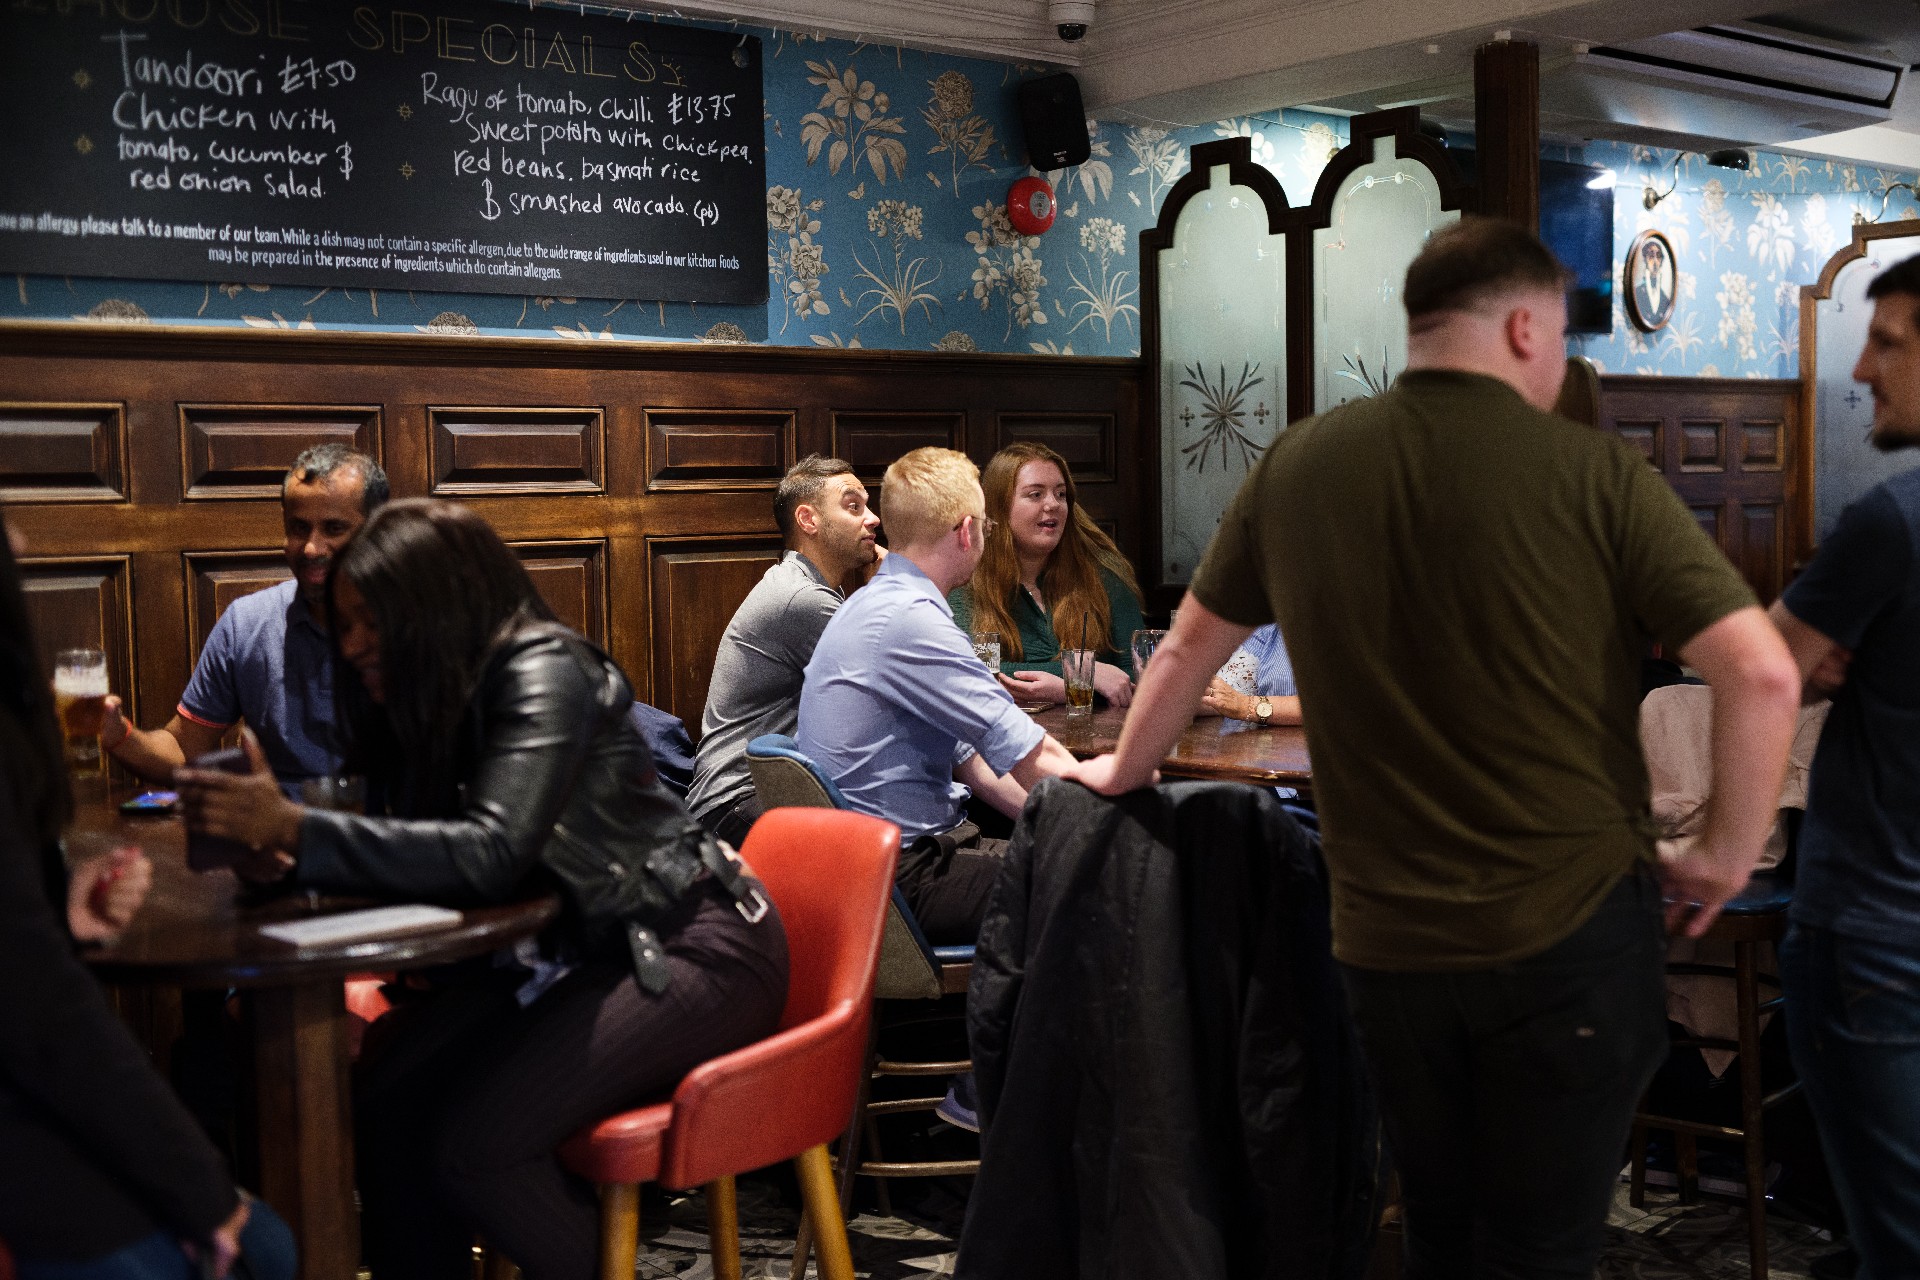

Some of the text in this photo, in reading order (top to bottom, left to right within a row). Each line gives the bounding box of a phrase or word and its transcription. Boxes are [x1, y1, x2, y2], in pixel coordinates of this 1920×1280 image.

[101, 28, 356, 96] Tandoori £7.50
[347, 7, 657, 82] SPECIALS
[113, 91, 335, 133] Chicken with
[421, 72, 478, 123] Ragu
[485, 89, 508, 111] of
[516, 83, 592, 115] tomato,
[667, 92, 736, 125] £13.75
[465, 112, 538, 143] Sweet
[541, 117, 602, 156] potato
[608, 127, 653, 148] with
[130, 165, 170, 190] red
[179, 167, 251, 192] onion
[453, 146, 491, 177] red
[582, 156, 655, 182] basmati
[661, 162, 701, 182] rice
[509, 192, 602, 216] smashed
[693, 199, 719, 227] (pb)
[19, 215, 34, 231] an
[37, 212, 78, 235] allergy
[81, 214, 119, 237] please
[121, 216, 146, 236] talk
[148, 217, 162, 237] to
[164, 224, 172, 238] a
[174, 222, 217, 241] member
[219, 224, 231, 241] of
[233, 229, 252, 242] our
[282, 227, 311, 246] While
[313, 233, 320, 246] a
[321, 230, 342, 247] dish
[343, 236, 365, 250] may
[367, 234, 385, 250] not
[387, 235, 422, 251] contain
[424, 240, 430, 252] a
[431, 238, 467, 255] specific
[506, 241, 523, 257] due
[523, 243, 533, 258] to
[534, 242, 548, 259] the
[549, 244, 569, 260] wide
[569, 249, 593, 263] range
[594, 247, 603, 261] of
[603, 247, 647, 265] ingredients
[647, 250, 665, 265] used
[665, 250, 673, 266] in
[673, 255, 687, 267] our
[687, 252, 717, 269] kitchen
[208, 248, 232, 264] may
[234, 246, 249, 263] be
[251, 250, 300, 268] prepared
[302, 249, 313, 267] in
[315, 249, 333, 267] the
[335, 254, 379, 270] presence
[381, 253, 392, 270] of
[394, 254, 445, 273] ingredients
[446, 257, 473, 274] which
[474, 258, 486, 275] do
[487, 260, 522, 277] contain
